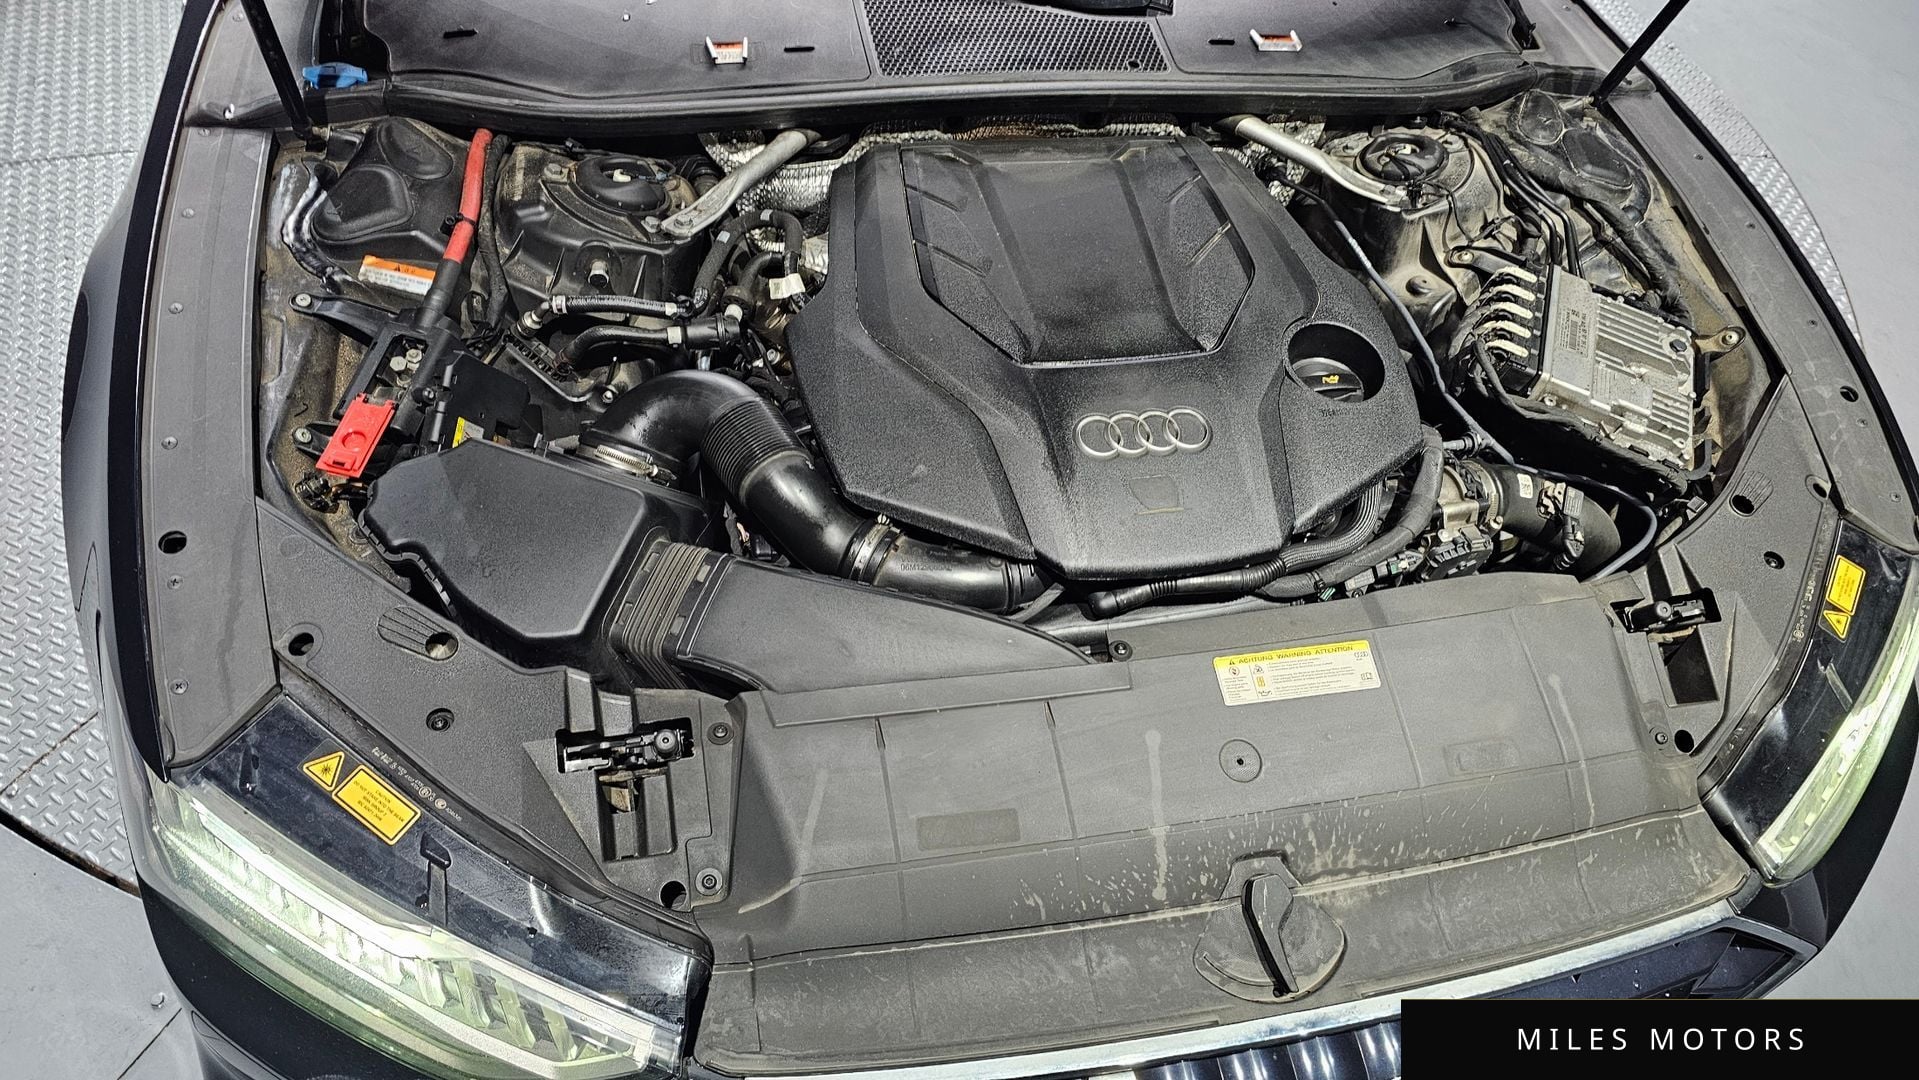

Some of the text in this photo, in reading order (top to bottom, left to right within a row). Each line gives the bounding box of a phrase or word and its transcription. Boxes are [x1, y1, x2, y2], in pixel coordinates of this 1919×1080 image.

[1238, 645, 1353, 664] ACHTUNG WARNING ATTENTION
